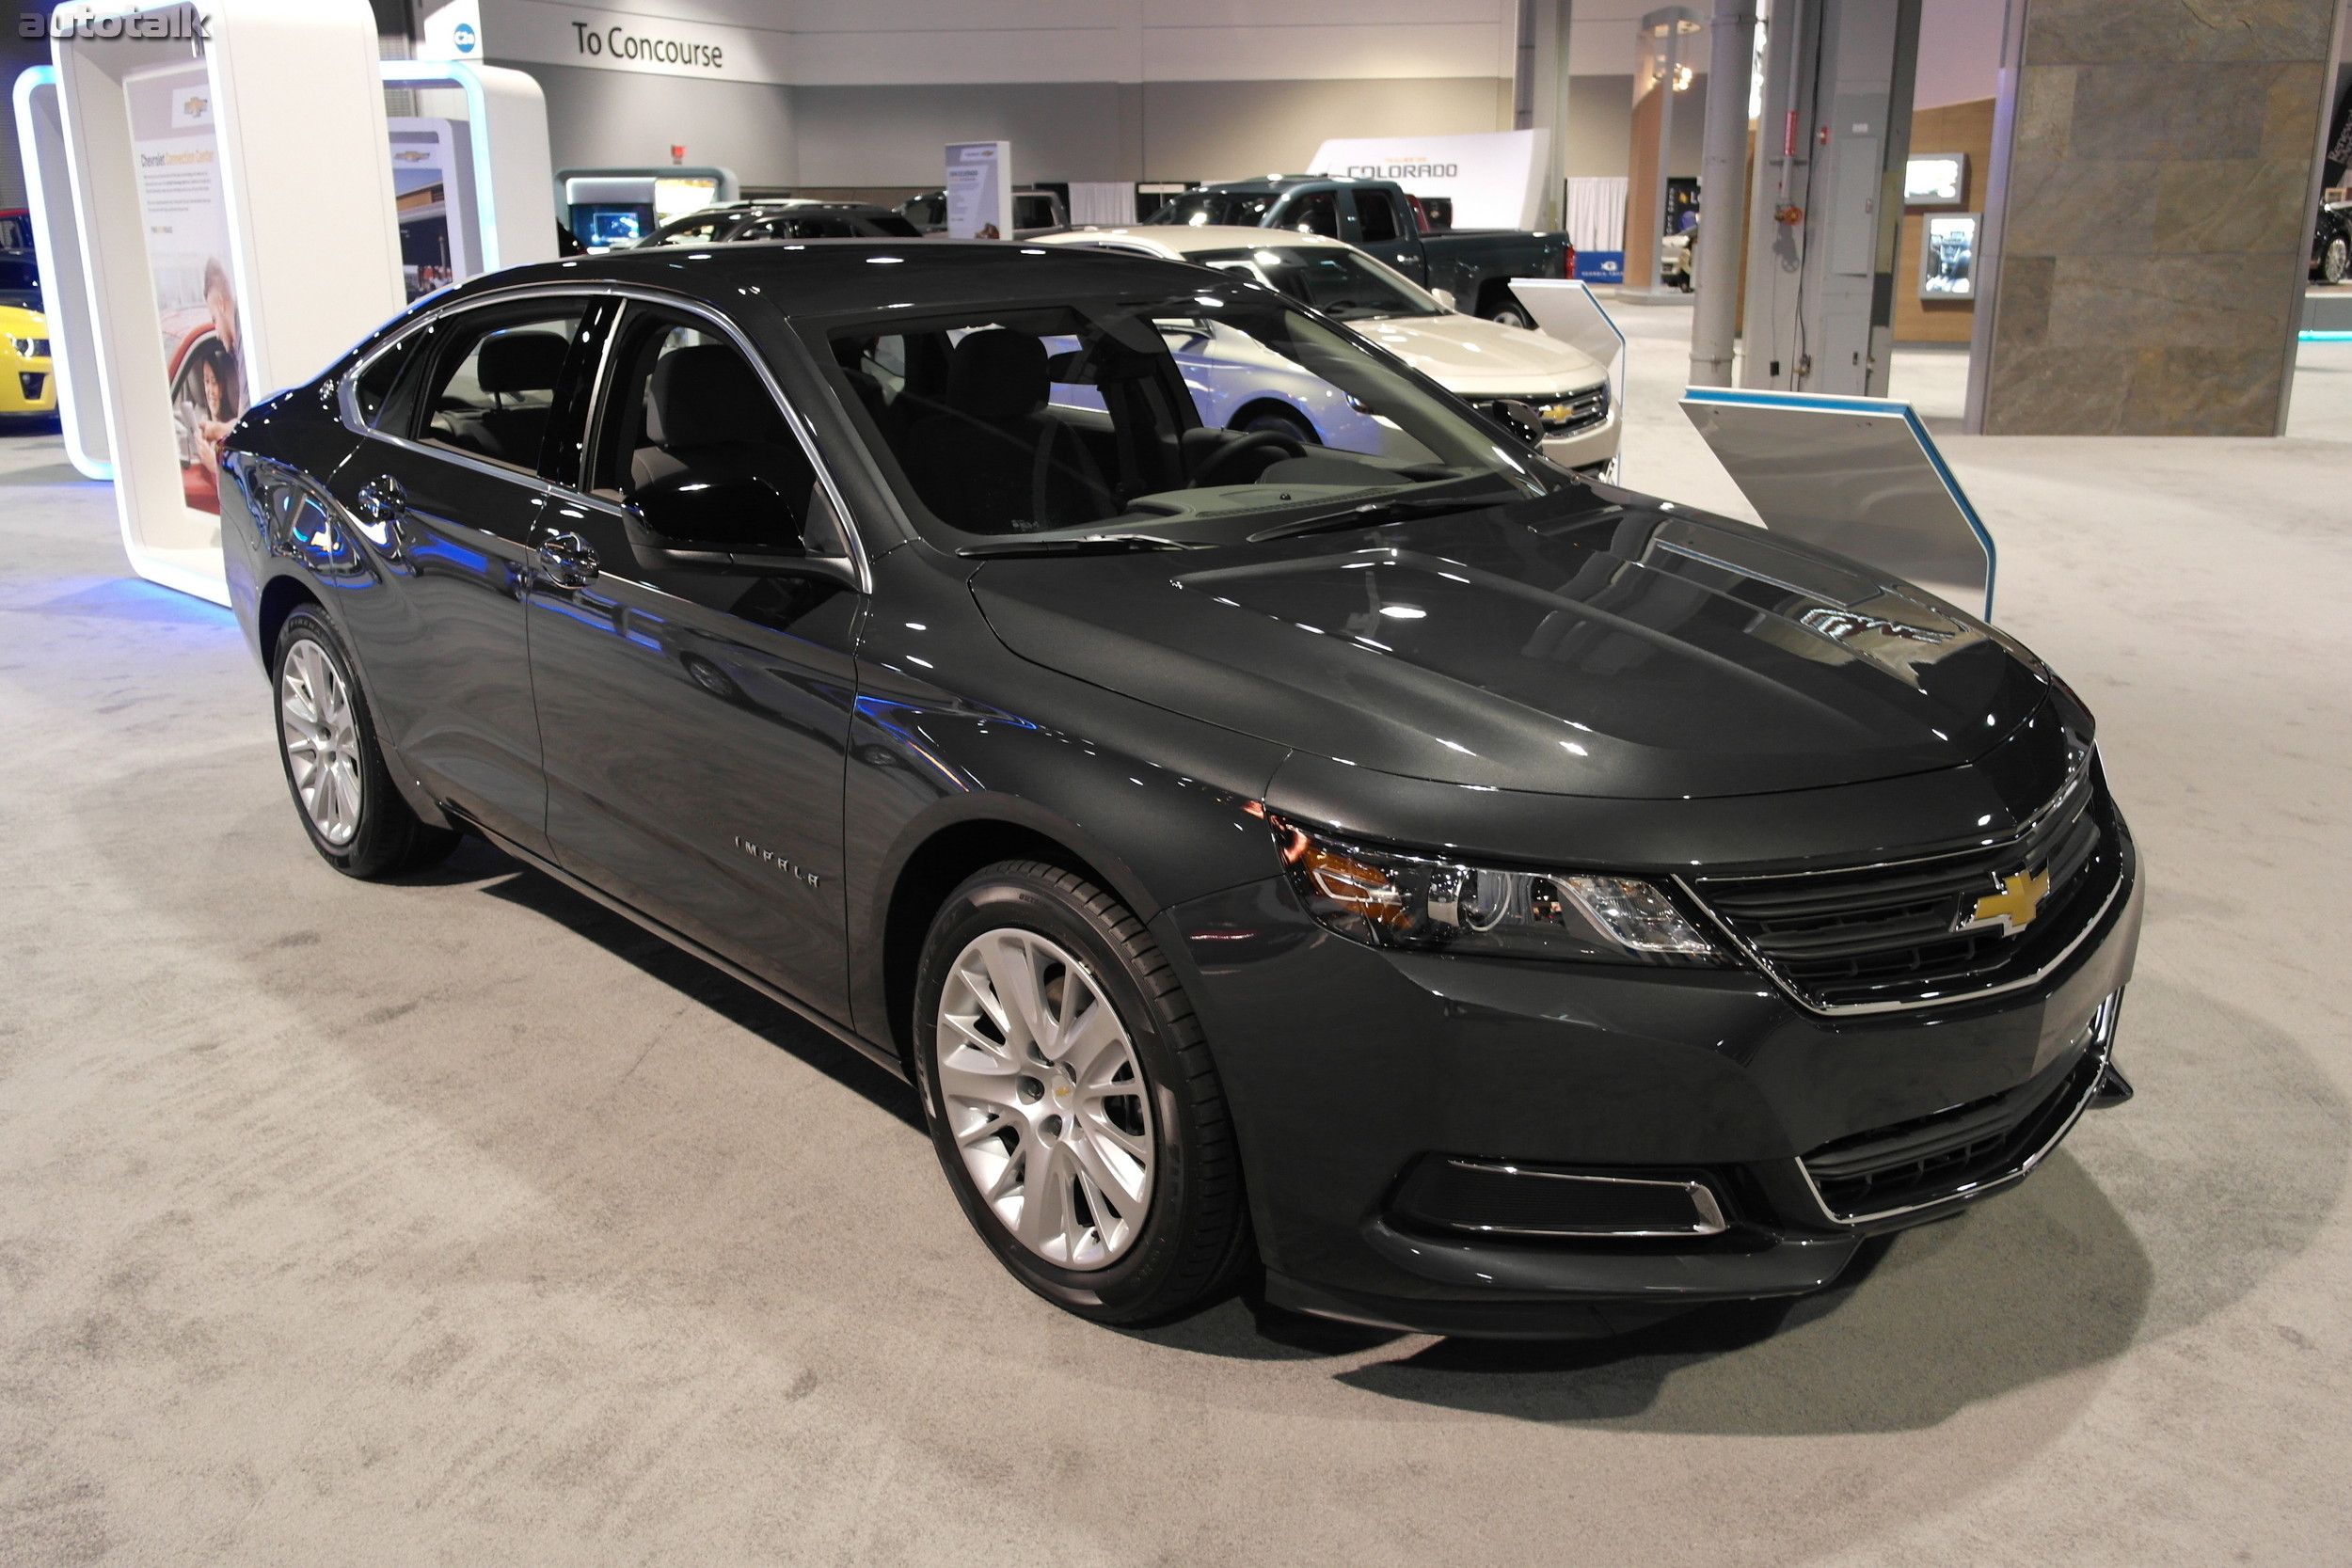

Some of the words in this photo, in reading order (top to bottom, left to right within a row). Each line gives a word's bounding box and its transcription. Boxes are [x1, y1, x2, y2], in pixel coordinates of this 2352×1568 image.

[572, 22, 602, 55] To
[608, 26, 723, 68] Concourse
[1347, 164, 1457, 180] COLORADO
[735, 836, 819, 888] IMPALA
